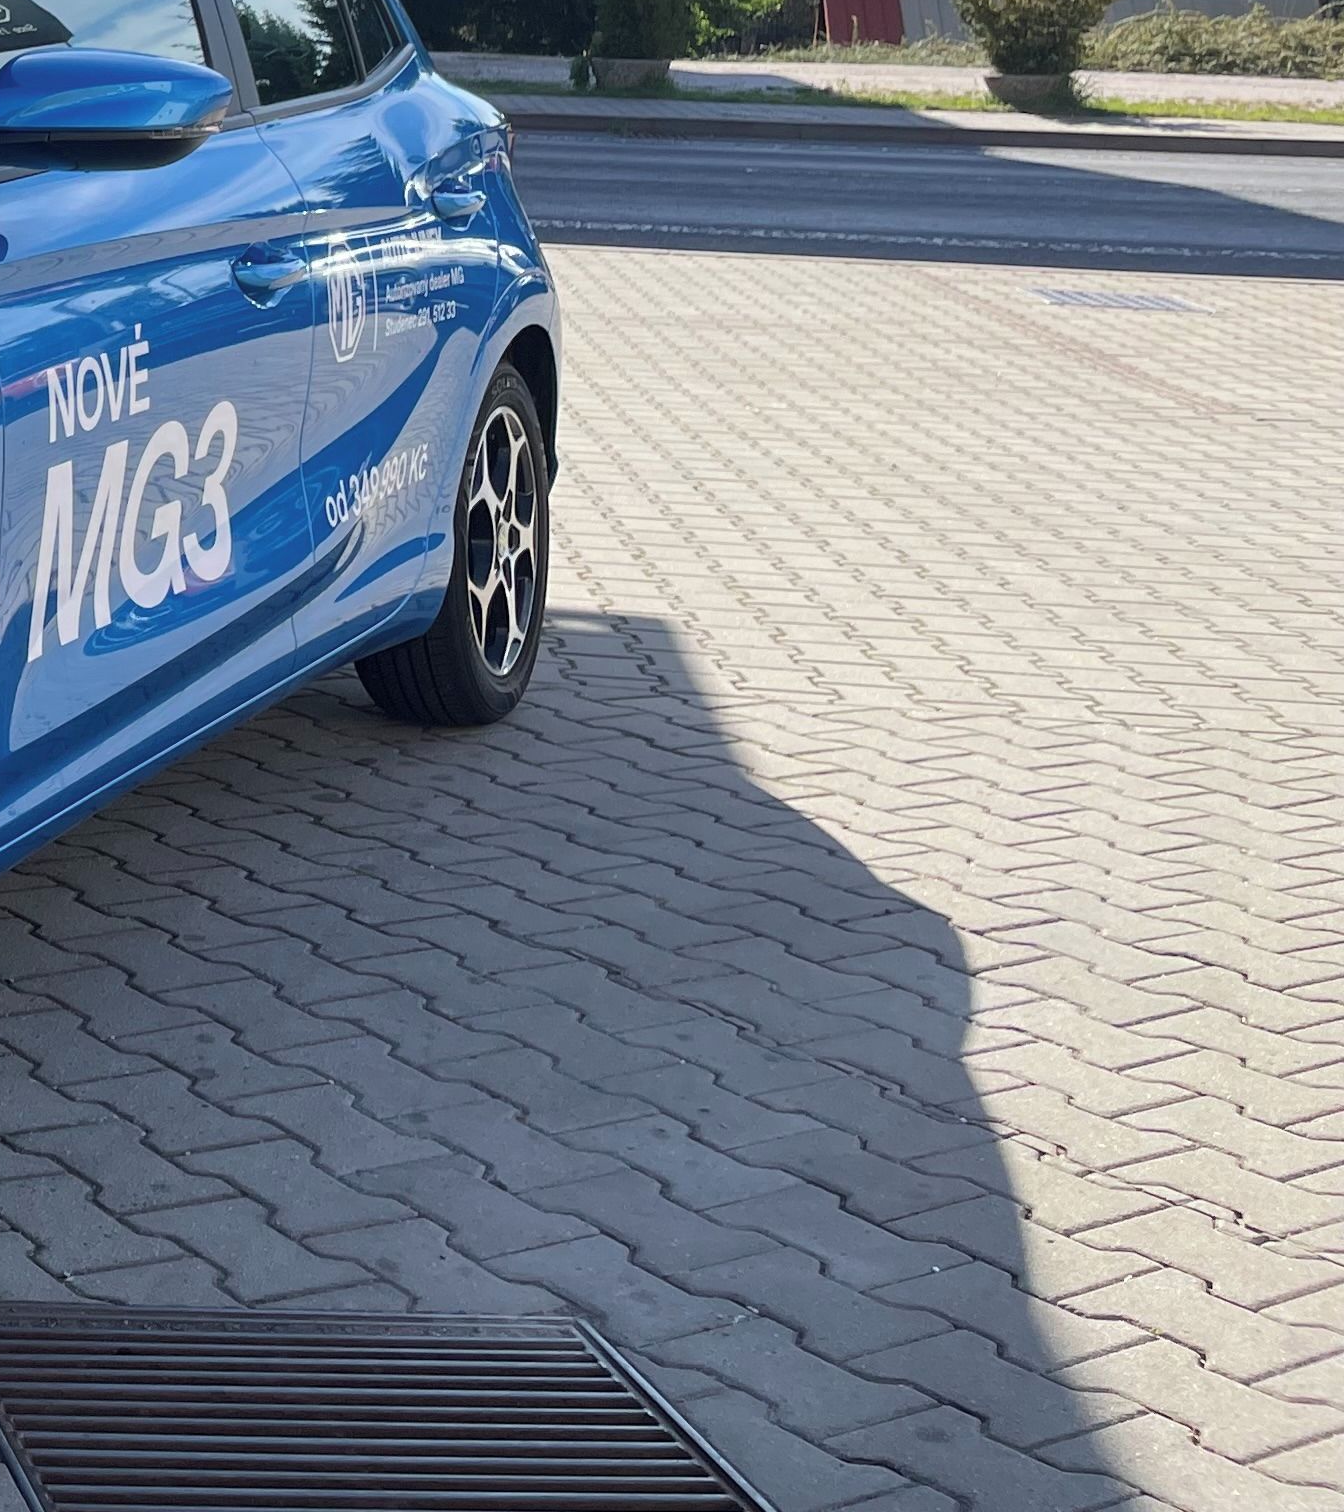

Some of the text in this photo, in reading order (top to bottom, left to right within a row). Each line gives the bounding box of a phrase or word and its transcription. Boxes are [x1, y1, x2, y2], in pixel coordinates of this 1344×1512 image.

[46, 324, 151, 444] NOVÉ
[28, 400, 239, 663] MG3
[325, 479, 349, 528] od
[408, 441, 429, 485] Kč
